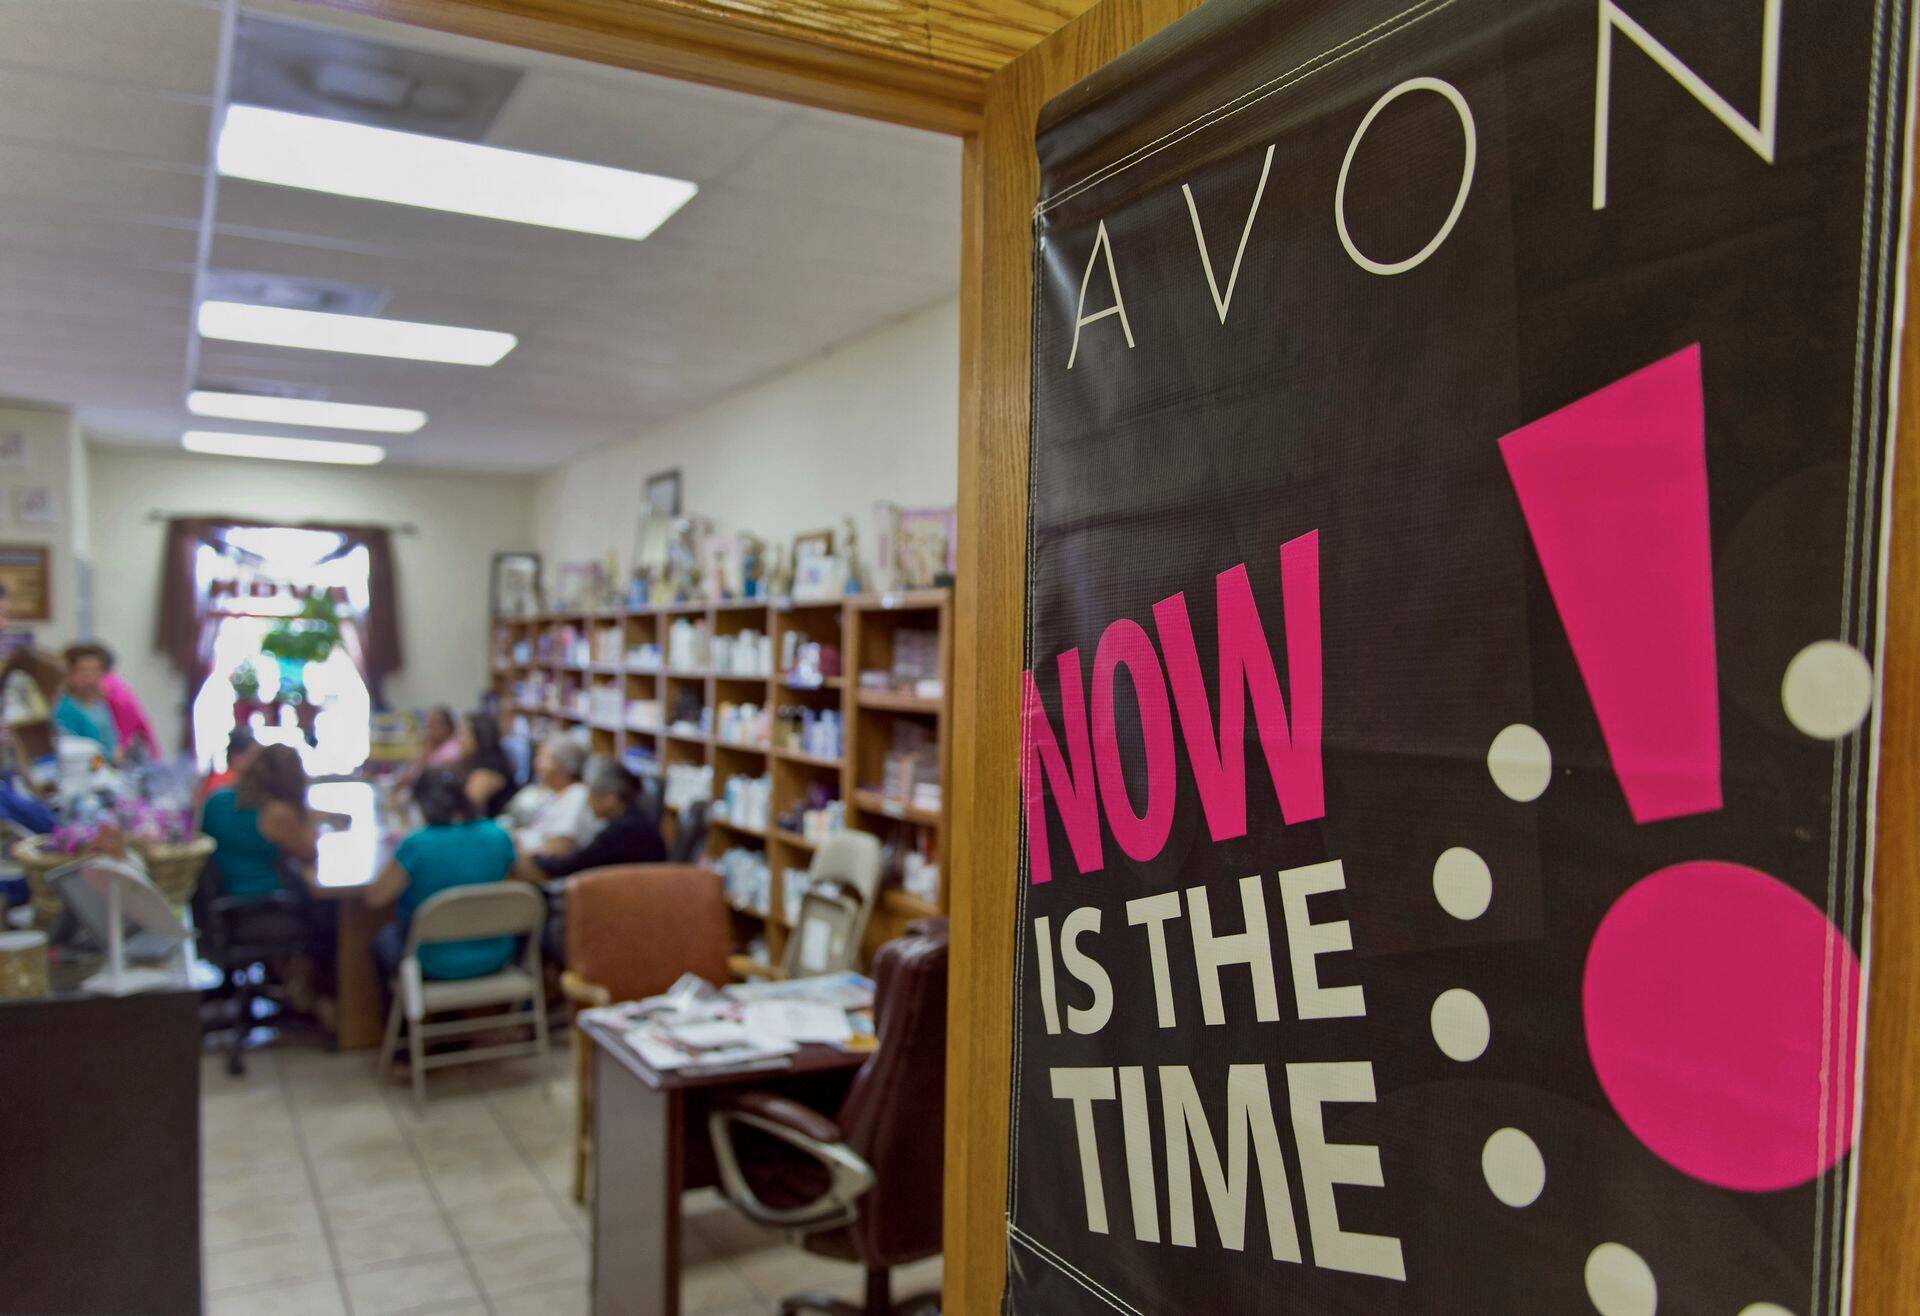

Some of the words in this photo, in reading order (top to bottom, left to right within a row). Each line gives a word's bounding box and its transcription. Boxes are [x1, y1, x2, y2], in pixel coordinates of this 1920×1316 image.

[1067, 0, 1782, 370] AVON
[1021, 529, 1325, 885] NOW
[1034, 906, 1114, 1035] IS
[1126, 859, 1366, 1029] THE
[1050, 1061, 1405, 1281] TIME
